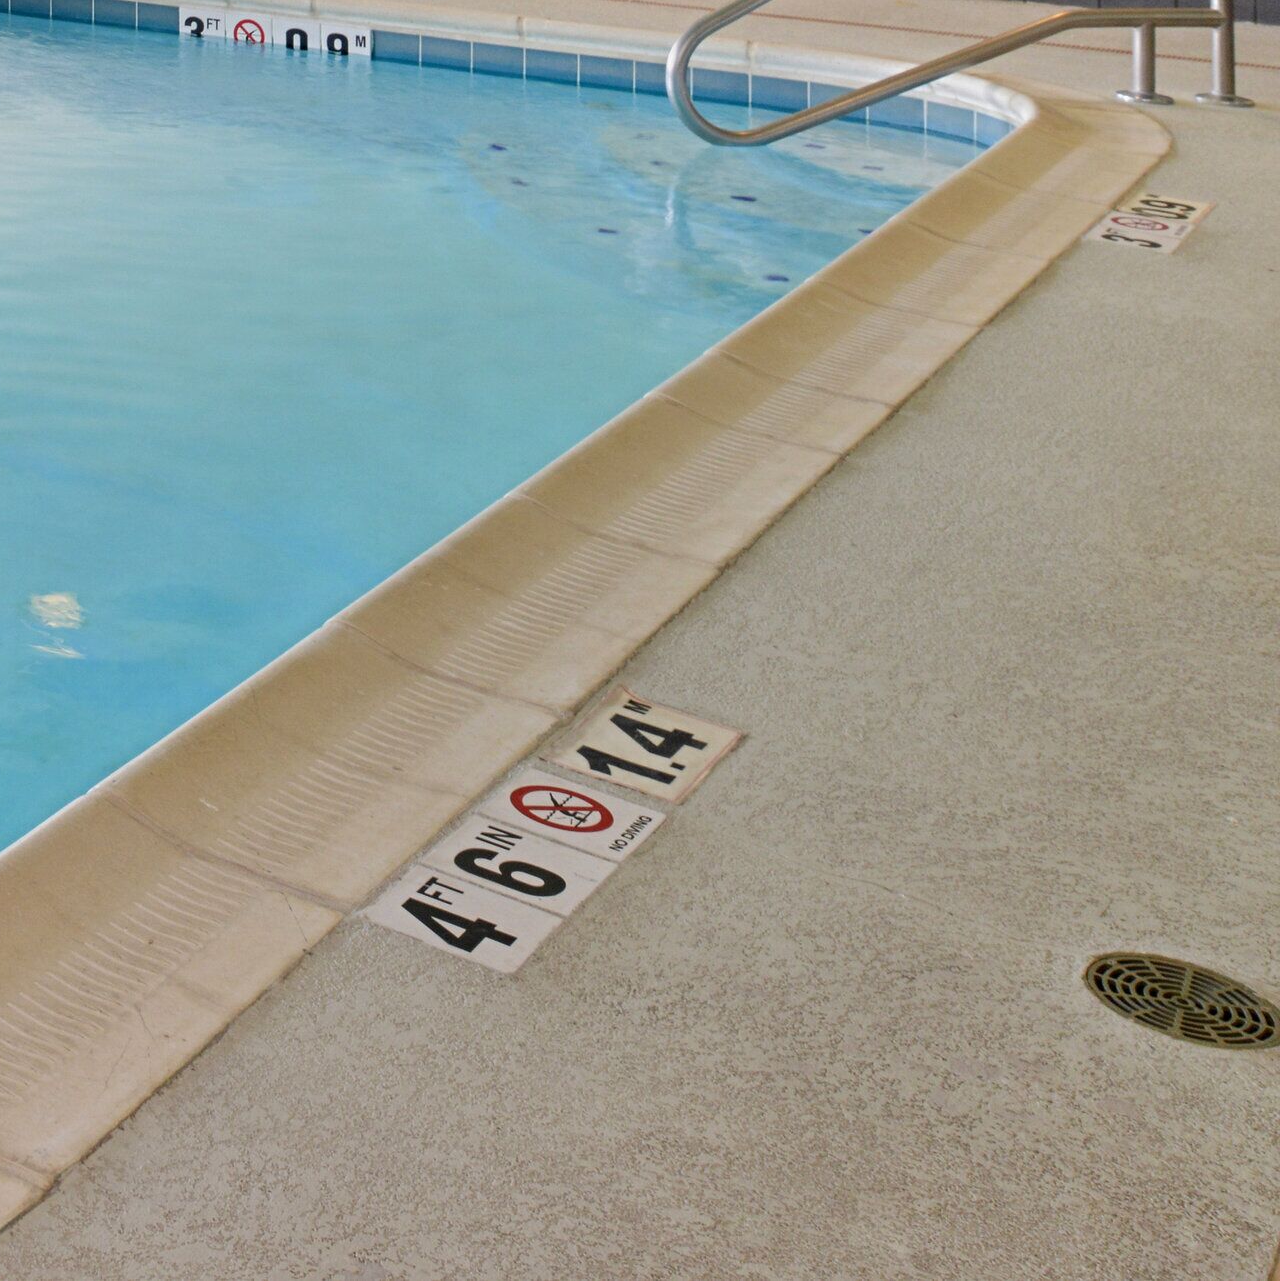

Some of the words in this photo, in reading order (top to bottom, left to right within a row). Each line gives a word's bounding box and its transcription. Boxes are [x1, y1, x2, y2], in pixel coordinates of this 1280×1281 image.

[206, 18, 220, 30] FT
[355, 35, 366, 48] M
[609, 839, 628, 852] NO
[621, 815, 652, 840] DIVING
